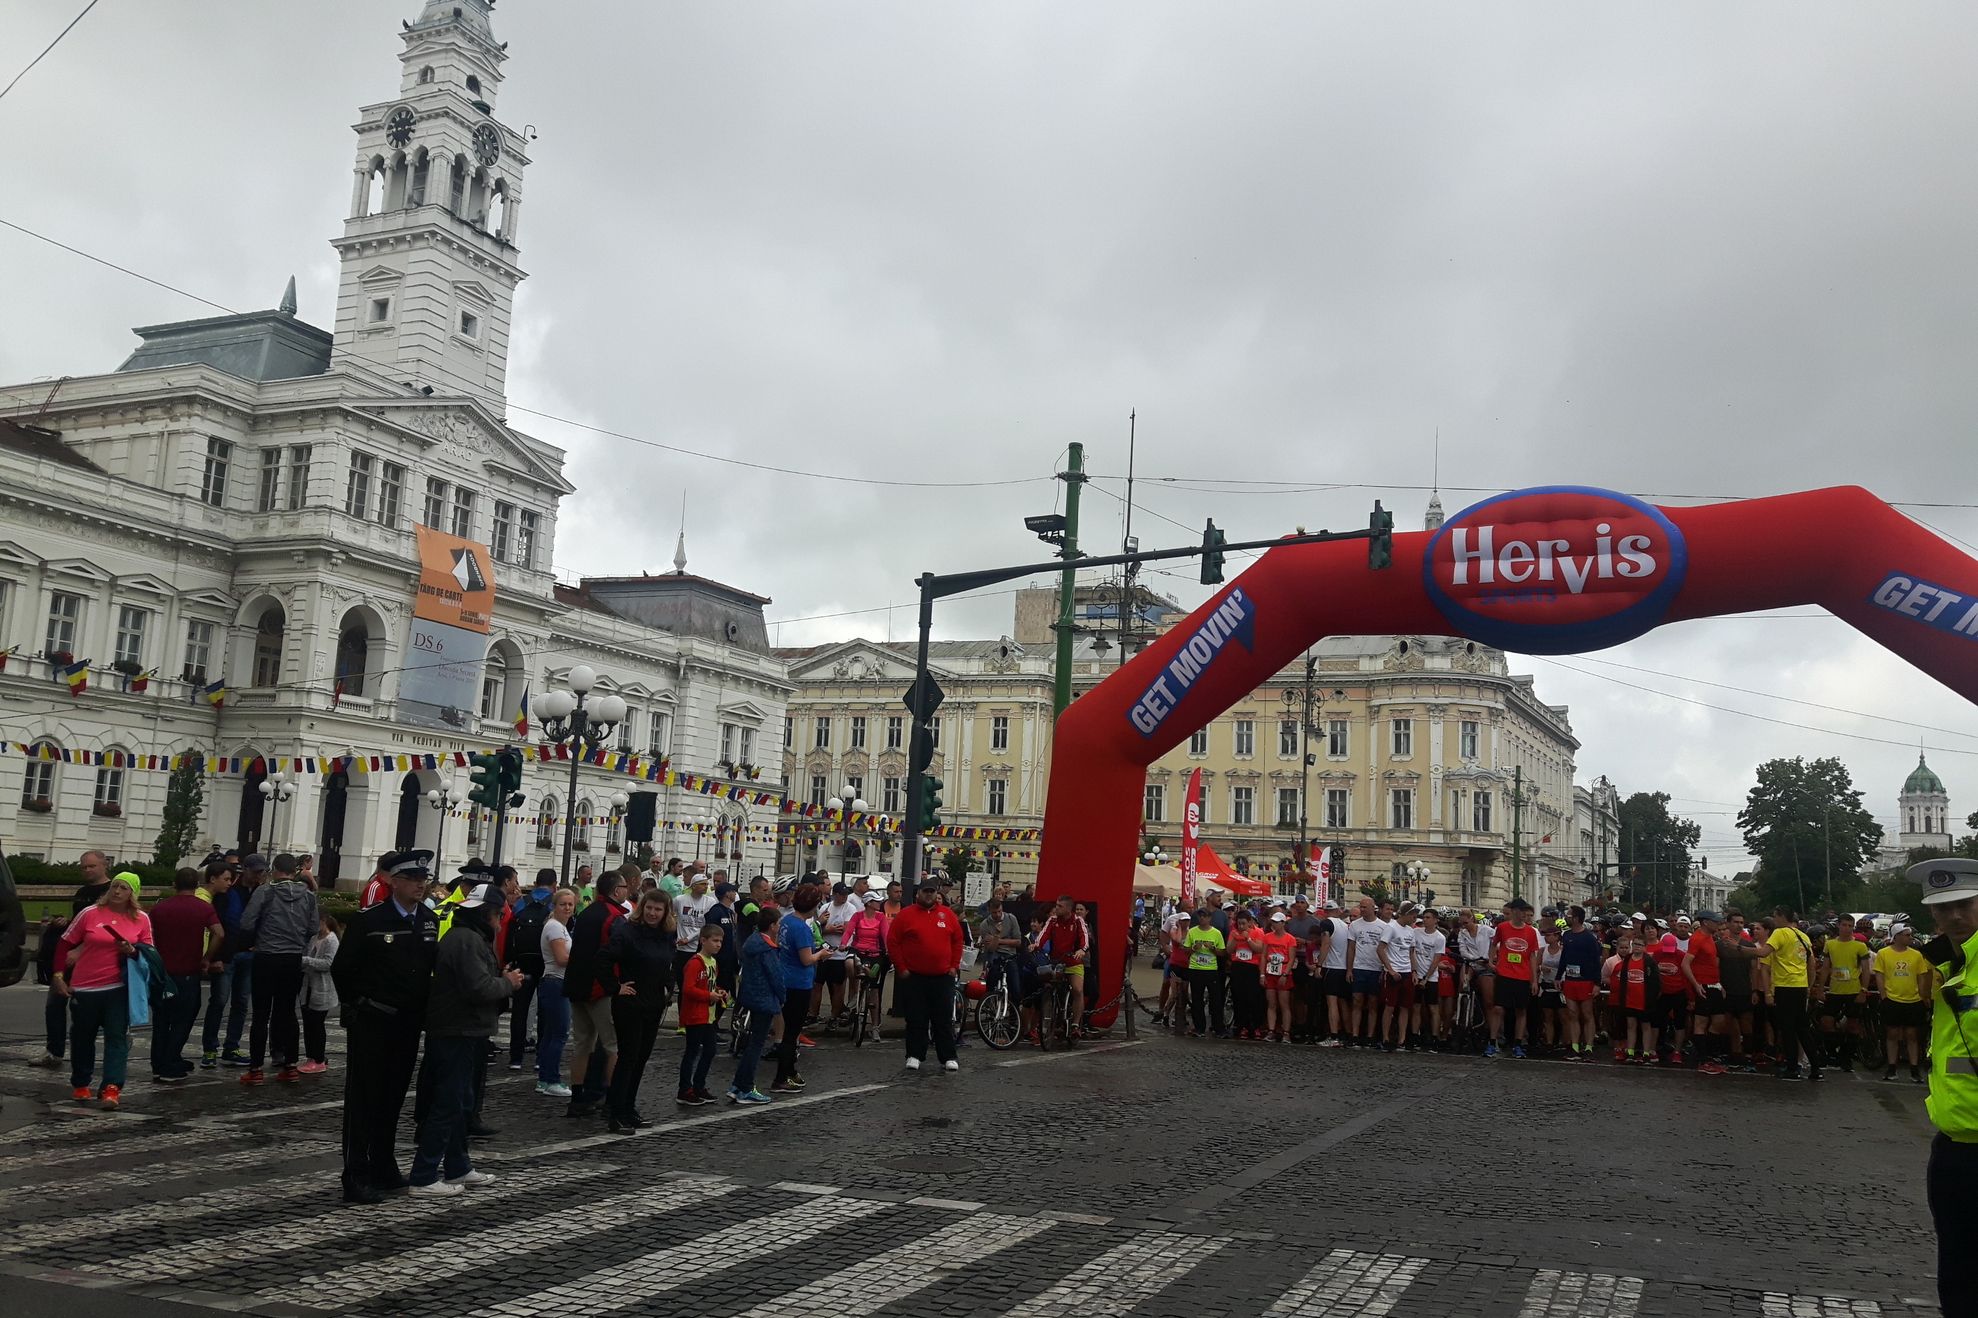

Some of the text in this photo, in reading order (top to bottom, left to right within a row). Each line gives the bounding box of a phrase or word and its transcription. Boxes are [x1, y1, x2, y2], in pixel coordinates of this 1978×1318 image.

[1452, 522, 1657, 594] Hervis
[1477, 587, 1558, 605] SPORTS
[1872, 575, 1963, 623] GET
[414, 632, 443, 652] DS 6
[1131, 588, 1246, 734] GET MOVIN'
[391, 733, 465, 752] VIA VERITAS VITA
